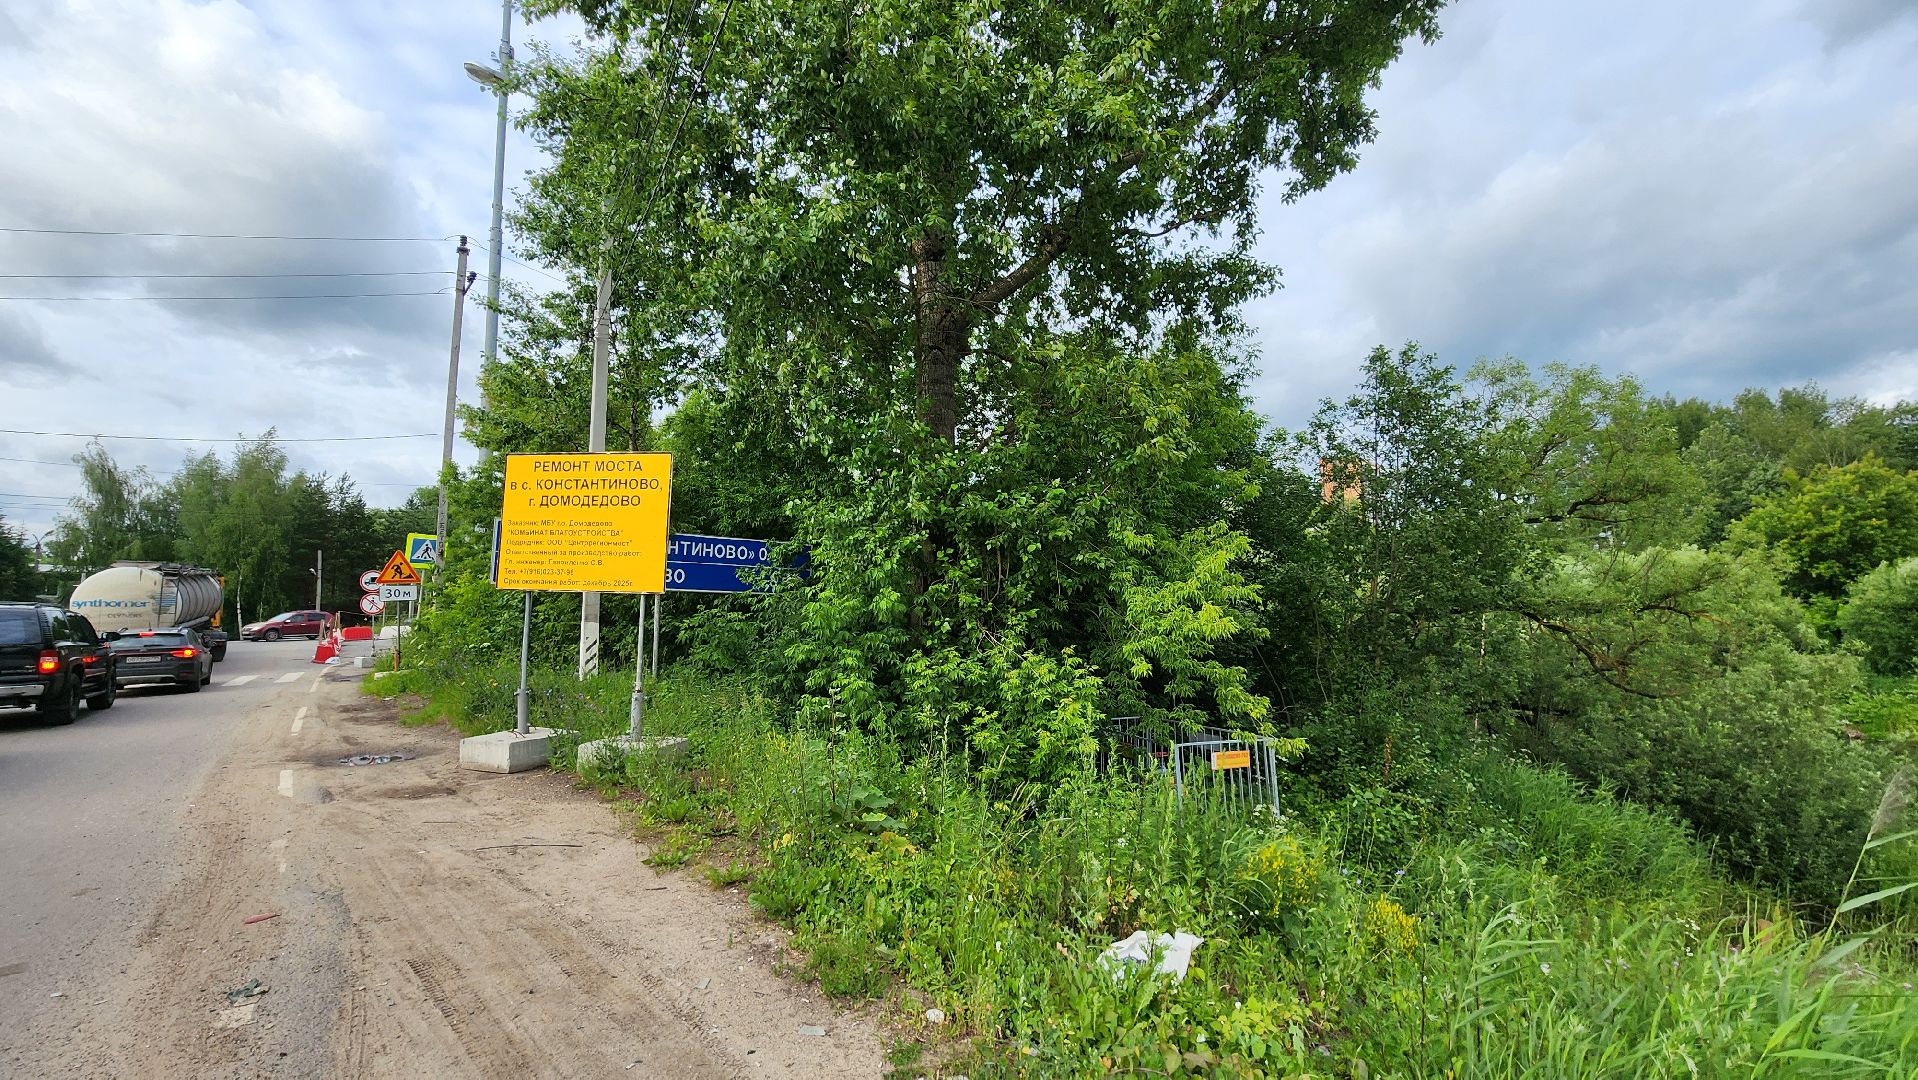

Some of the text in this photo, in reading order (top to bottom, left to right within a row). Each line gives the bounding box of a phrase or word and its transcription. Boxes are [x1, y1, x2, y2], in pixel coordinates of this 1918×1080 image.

[534, 460, 643, 472] РЕМОНТ МОСТА
[521, 482, 532, 490] с.
[536, 479, 663, 492] КОНСТАНТИНОВО,
[528, 495, 641, 508] г. ДОМОДЕДОВО
[668, 540, 755, 560] НТИНОВО»
[559, 579, 581, 587] работ:
[385, 589, 411, 598] 30 м
[72, 599, 151, 609] synthomer
